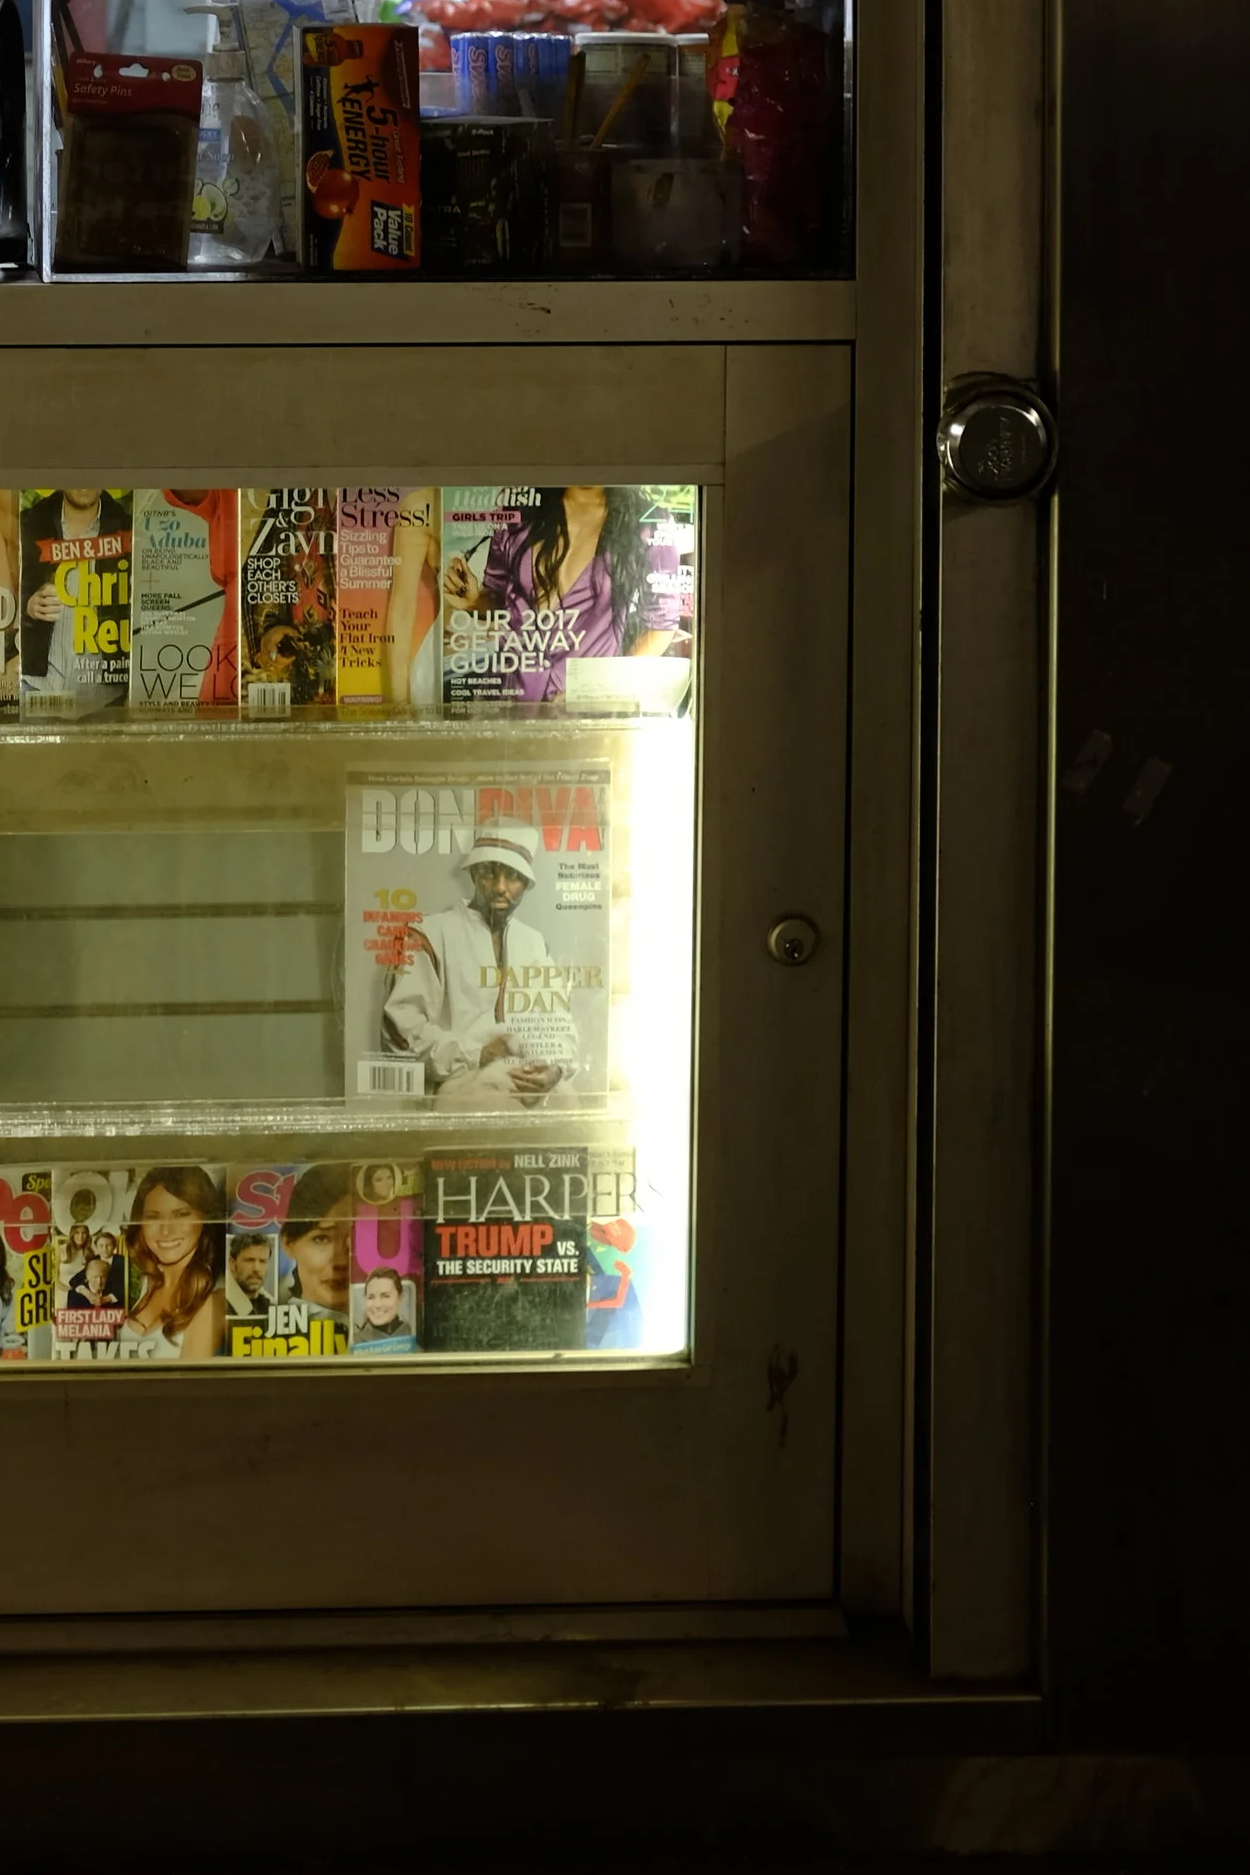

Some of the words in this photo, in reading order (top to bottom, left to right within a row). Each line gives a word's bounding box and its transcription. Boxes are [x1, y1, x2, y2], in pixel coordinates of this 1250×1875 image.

[73, 82, 108, 98] Safety
[110, 85, 132, 97] Pins
[341, 97, 372, 182] ENERGY
[366, 106, 399, 183] 5-hour
[374, 205, 387, 251] Pack
[387, 207, 401, 255] Value
[276, 511, 288, 527] &
[341, 503, 430, 528] Stress!
[452, 513, 486, 521] GIRLS
[490, 513, 515, 521] TRIP
[249, 517, 338, 571] Zayn
[340, 529, 387, 544] Sizzling
[51, 542, 80, 562] BEN
[83, 540, 95, 558] &
[97, 536, 122, 557] JEN
[340, 542, 365, 556] Tips
[366, 543, 379, 554] to
[247, 557, 281, 569] SHOP
[340, 554, 402, 566] Guarantee
[247, 569, 281, 581] EACH
[349, 565, 392, 577] Blissful
[247, 580, 296, 593] OTHER'S
[340, 577, 392, 589] Summer
[247, 592, 299, 604] CLOSETS
[340, 608, 378, 619] Teach
[450, 609, 511, 631] OUR
[520, 609, 580, 630] 2017
[340, 620, 370, 631] Your
[340, 632, 364, 643] Flat
[368, 632, 395, 643] Iron
[450, 630, 586, 652] GETAWAY
[75, 656, 100, 670] After
[140, 644, 237, 672] LOOK
[340, 657, 382, 668] Tricks
[450, 652, 544, 673] GUIDE!
[77, 671, 94, 683] call
[140, 673, 198, 700] WE
[472, 688, 501, 696] TRAVEL
[556, 881, 602, 891] FEMALE
[374, 888, 417, 911] 10
[562, 892, 595, 901] DRUG
[478, 965, 604, 988] DAPPER
[506, 991, 571, 1013] DAN
[514, 1154, 545, 1168] NELL
[547, 1154, 580, 1168] ZINK
[436, 1222, 554, 1258] TRUMP
[556, 1240, 580, 1256] VS.
[437, 1260, 463, 1275] THE
[466, 1259, 533, 1274] SECURITY
[536, 1259, 578, 1274] STATE
[57, 1309, 90, 1324] FIRST
[91, 1309, 124, 1323] LADY
[265, 1304, 307, 1337] JEN
[57, 1324, 111, 1337] MELANIA
